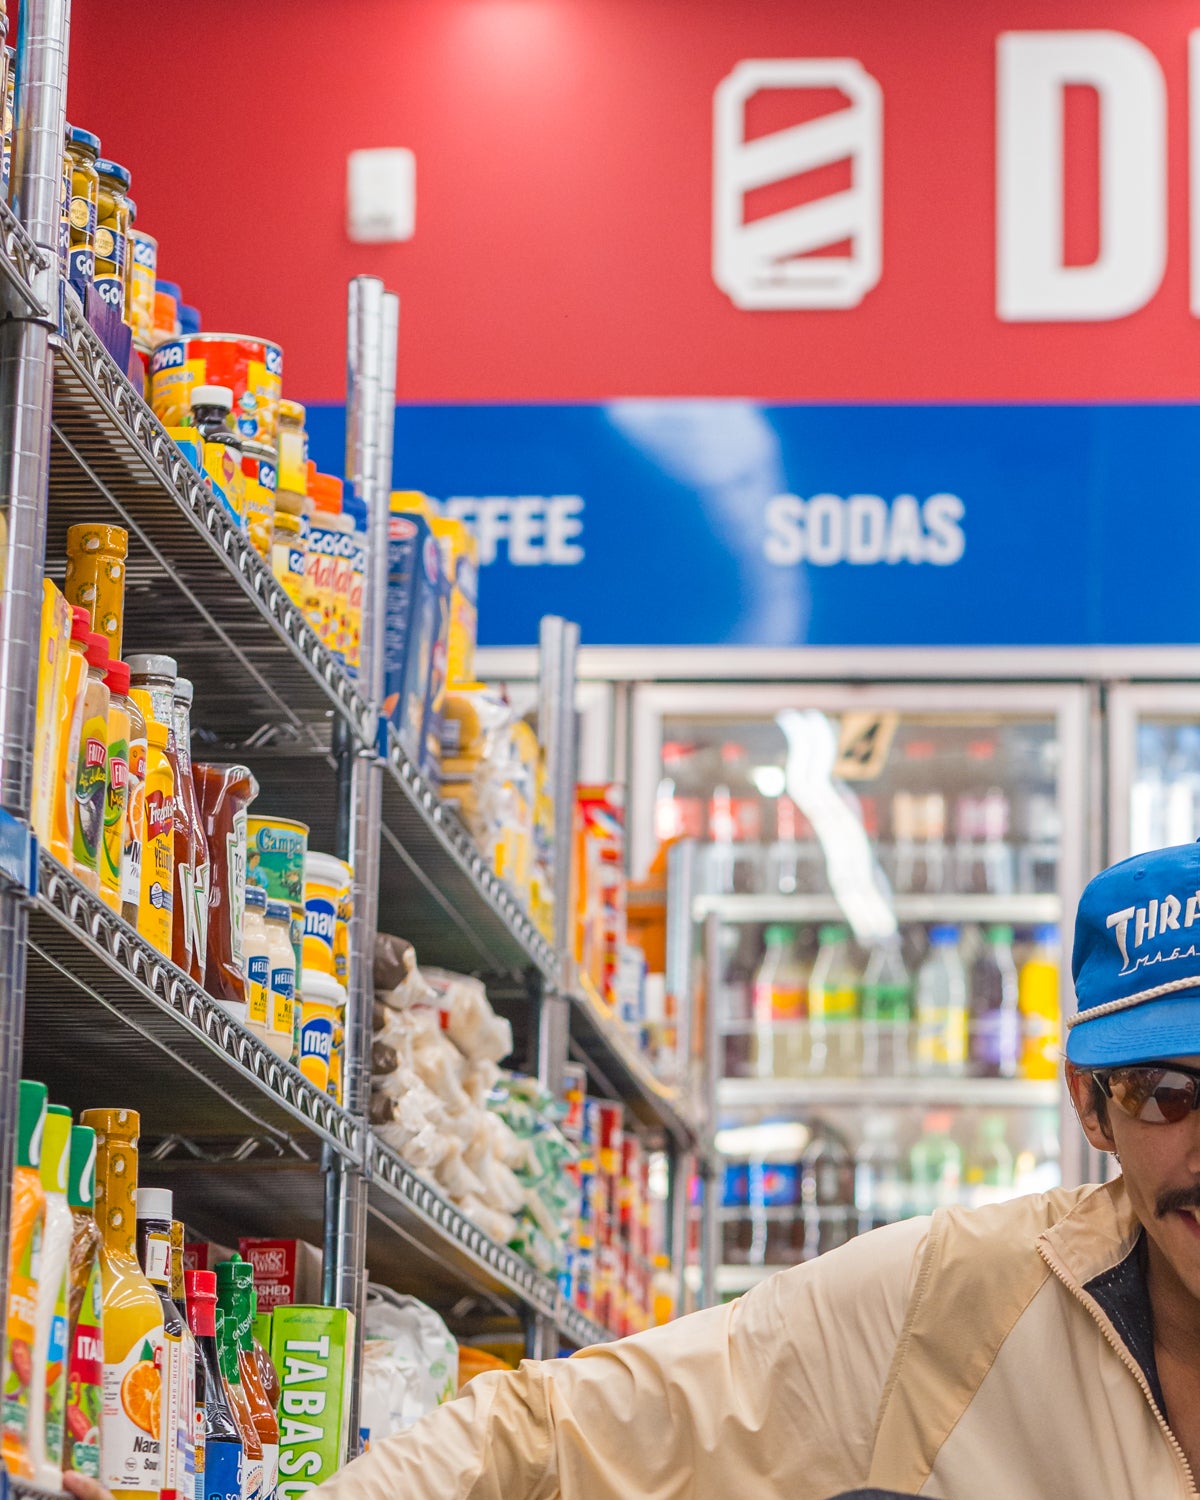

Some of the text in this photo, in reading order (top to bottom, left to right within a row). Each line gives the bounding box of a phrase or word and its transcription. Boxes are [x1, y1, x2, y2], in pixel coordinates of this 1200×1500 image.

[99, 284, 121, 305] GO
[446, 495, 585, 566] FFEE
[764, 494, 965, 566] SODAS
[133, 1436, 160, 1454] Nara
